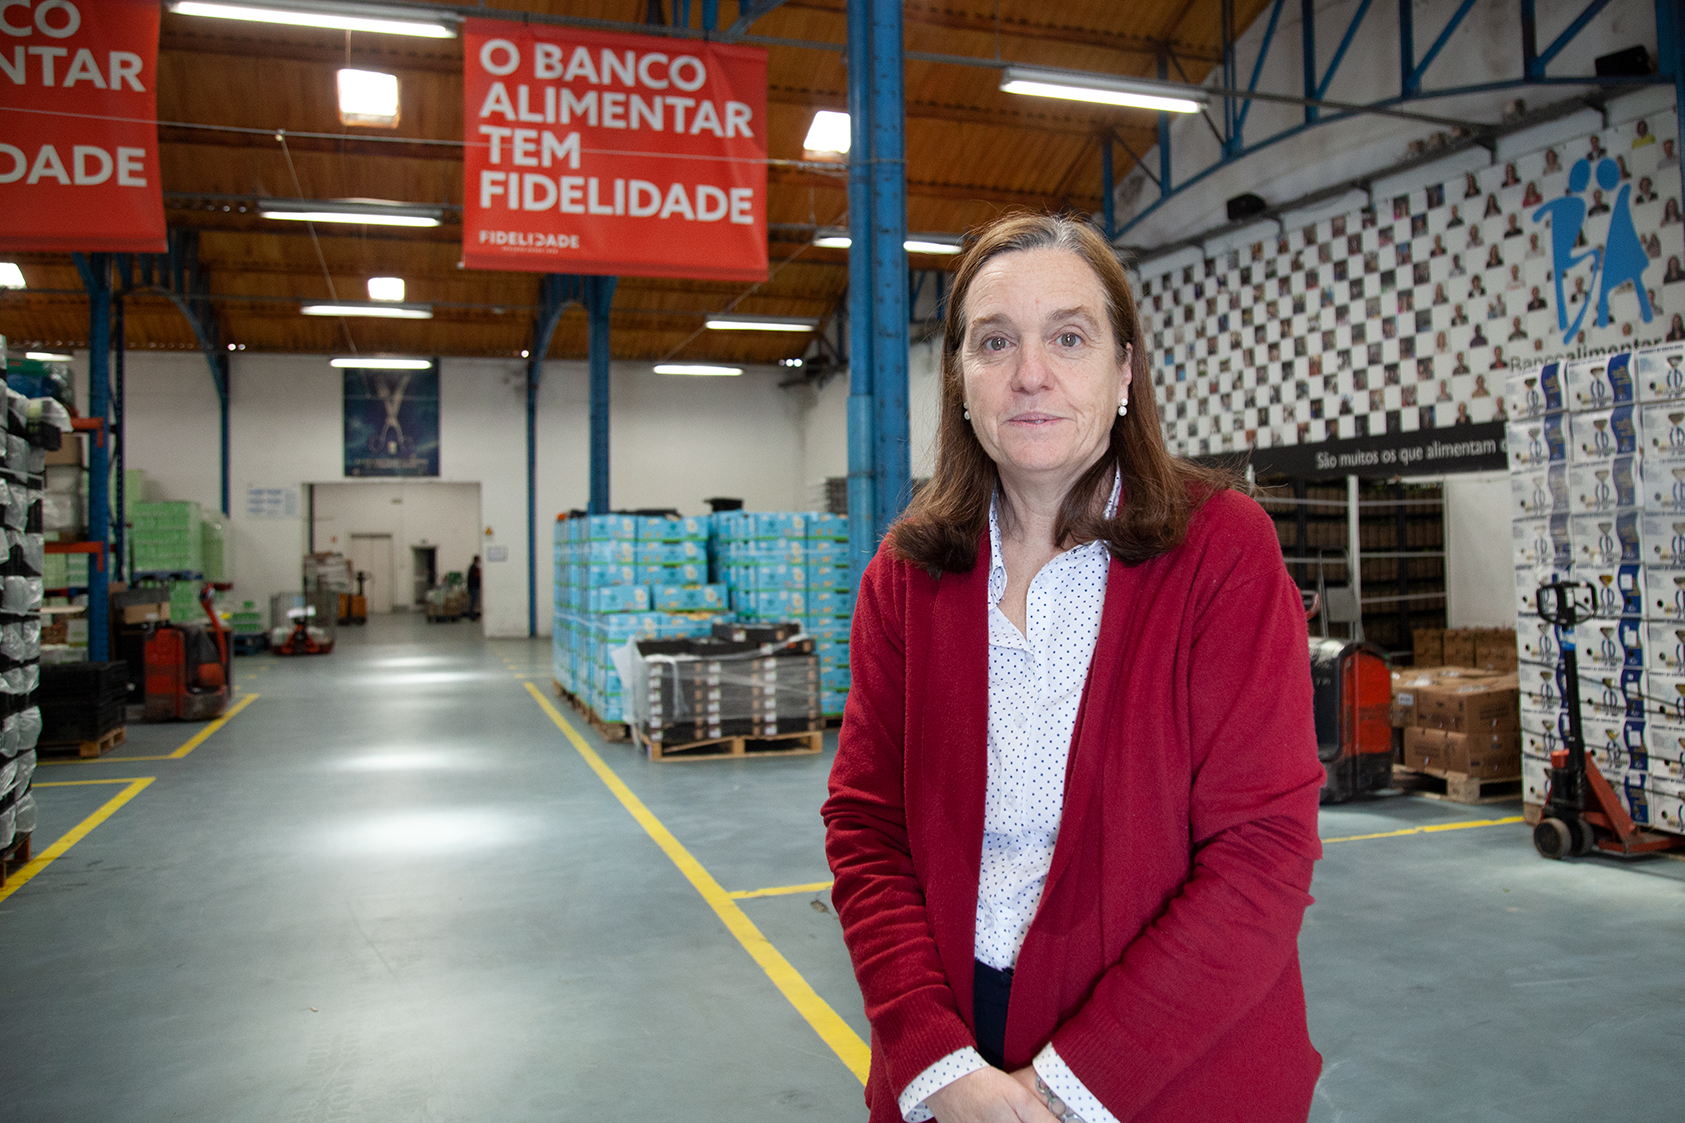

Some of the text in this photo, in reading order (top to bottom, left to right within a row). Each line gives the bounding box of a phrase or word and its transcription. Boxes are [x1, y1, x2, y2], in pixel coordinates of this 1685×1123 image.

[0, 0, 81, 38] CO
[480, 39, 707, 92] O BANCO
[480, 82, 753, 138] ALIMENTAR
[479, 125, 580, 169] TEM
[480, 170, 754, 225] FIDELIDADE
[479, 230, 580, 249] FIDELIDADE
[1316, 451, 1337, 470] São
[1338, 449, 1379, 467] muitos
[1381, 448, 1397, 464] os
[1398, 445, 1423, 466] que
[1426, 440, 1496, 460] alimentam
